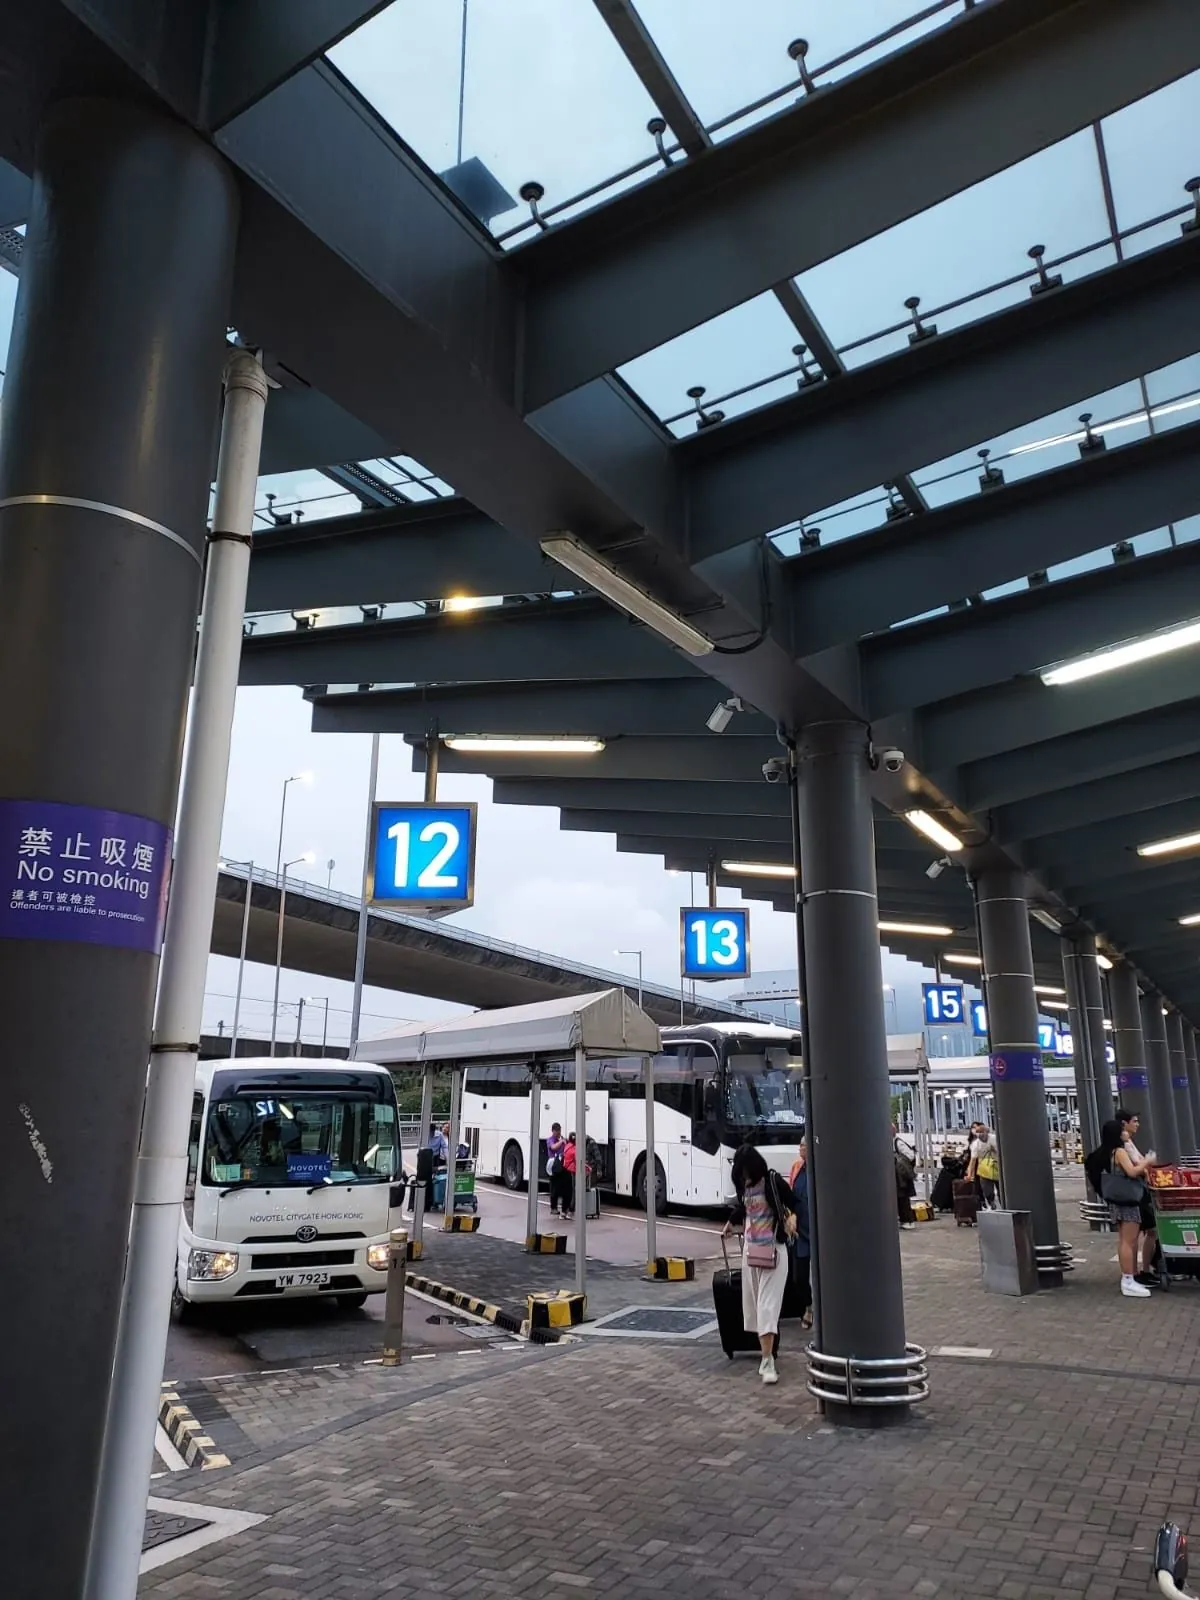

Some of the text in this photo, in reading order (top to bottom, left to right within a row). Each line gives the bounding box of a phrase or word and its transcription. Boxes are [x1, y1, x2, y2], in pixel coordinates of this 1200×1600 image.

[18, 827, 155, 873] 禁止吸煙
[387, 821, 460, 888] 12
[17, 860, 150, 899] No smoking
[10, 900, 55, 911] Offenders
[73, 905, 97, 915] liable
[98, 908, 107, 916] to
[107, 910, 145, 923] prosecution
[691, 919, 739, 966] 13
[927, 989, 960, 1022] 15
[288, 1164, 328, 1172] NOVOTEL
[249, 1212, 363, 1222] NOVOTEL CITYGATE HONG KONG
[279, 1273, 329, 1286] YW 7923
